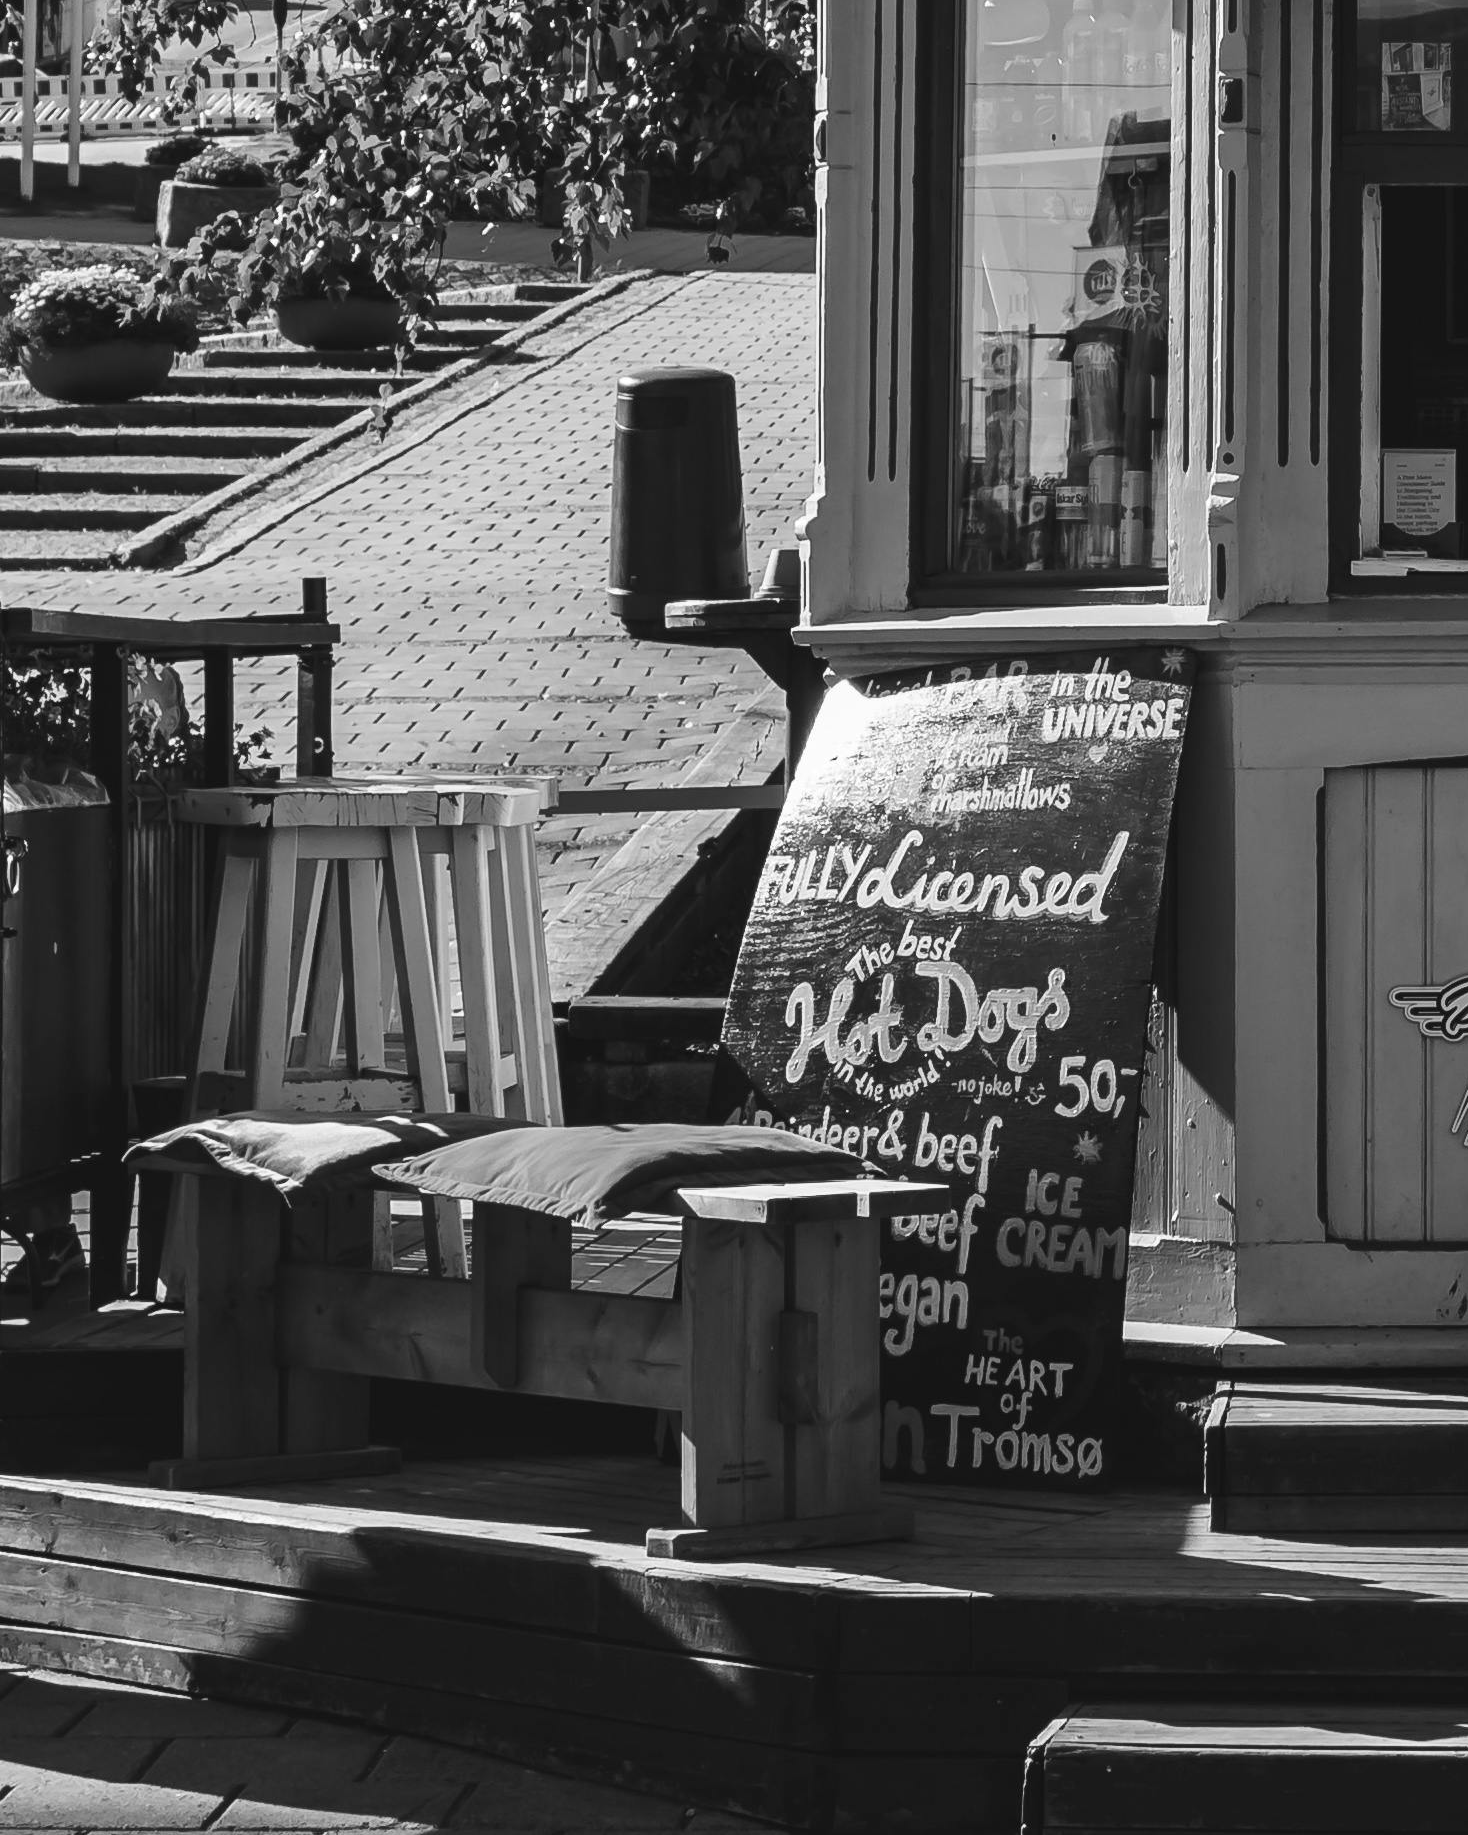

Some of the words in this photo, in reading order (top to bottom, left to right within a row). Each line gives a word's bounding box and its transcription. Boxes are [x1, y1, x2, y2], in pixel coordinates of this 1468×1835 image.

[1051, 669, 1074, 697] in
[1086, 657, 1131, 700] the
[1042, 697, 1184, 743] UNIVERSE
[930, 767, 1072, 813] marshmallows
[766, 843, 871, 906] FULLY
[857, 830, 1130, 922] Licensed
[845, 935, 896, 983] The
[898, 919, 963, 962] best
[785, 972, 907, 1083] Hot
[832, 1059, 857, 1084] in
[855, 1072, 884, 1102] the
[1055, 1055, 1139, 1119] 50,-
[877, 1110, 908, 1161] &
[914, 1111, 1003, 1193] beef
[1025, 1168, 1084, 1218] ICE
[996, 1218, 1127, 1281] CREAM
[983, 1329, 1025, 1355] The
[1000, 1391, 1033, 1430] of
[930, 1403, 1103, 1478] Tromsø
